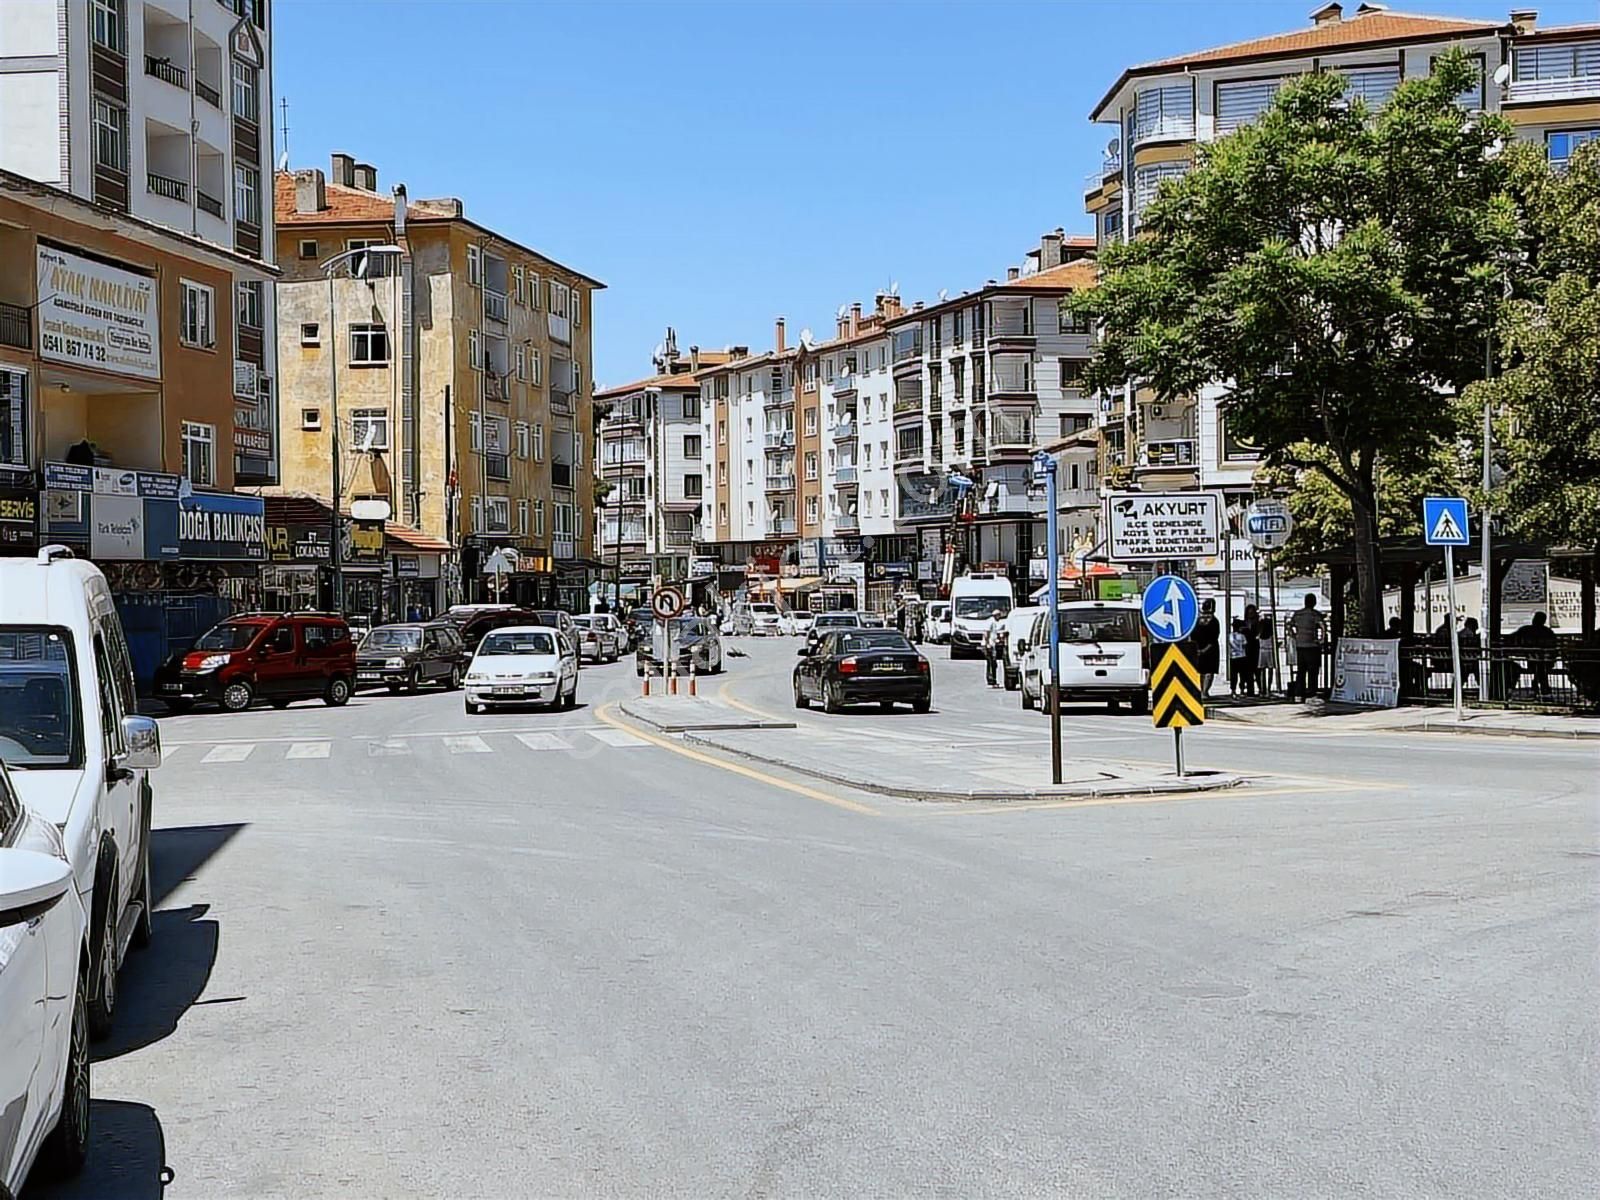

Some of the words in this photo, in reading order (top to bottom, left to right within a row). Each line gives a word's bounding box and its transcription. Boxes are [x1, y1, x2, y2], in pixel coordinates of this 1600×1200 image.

[43, 333, 63, 353] 0541
[95, 346, 106, 362] 32
[1143, 502, 1207, 515] AKYURT
[179, 503, 211, 541] DOĞA
[213, 512, 264, 548] BALIKÇISI
[1153, 528, 1167, 536] VE
[1128, 545, 1204, 555] YAPILMAKTADIR
